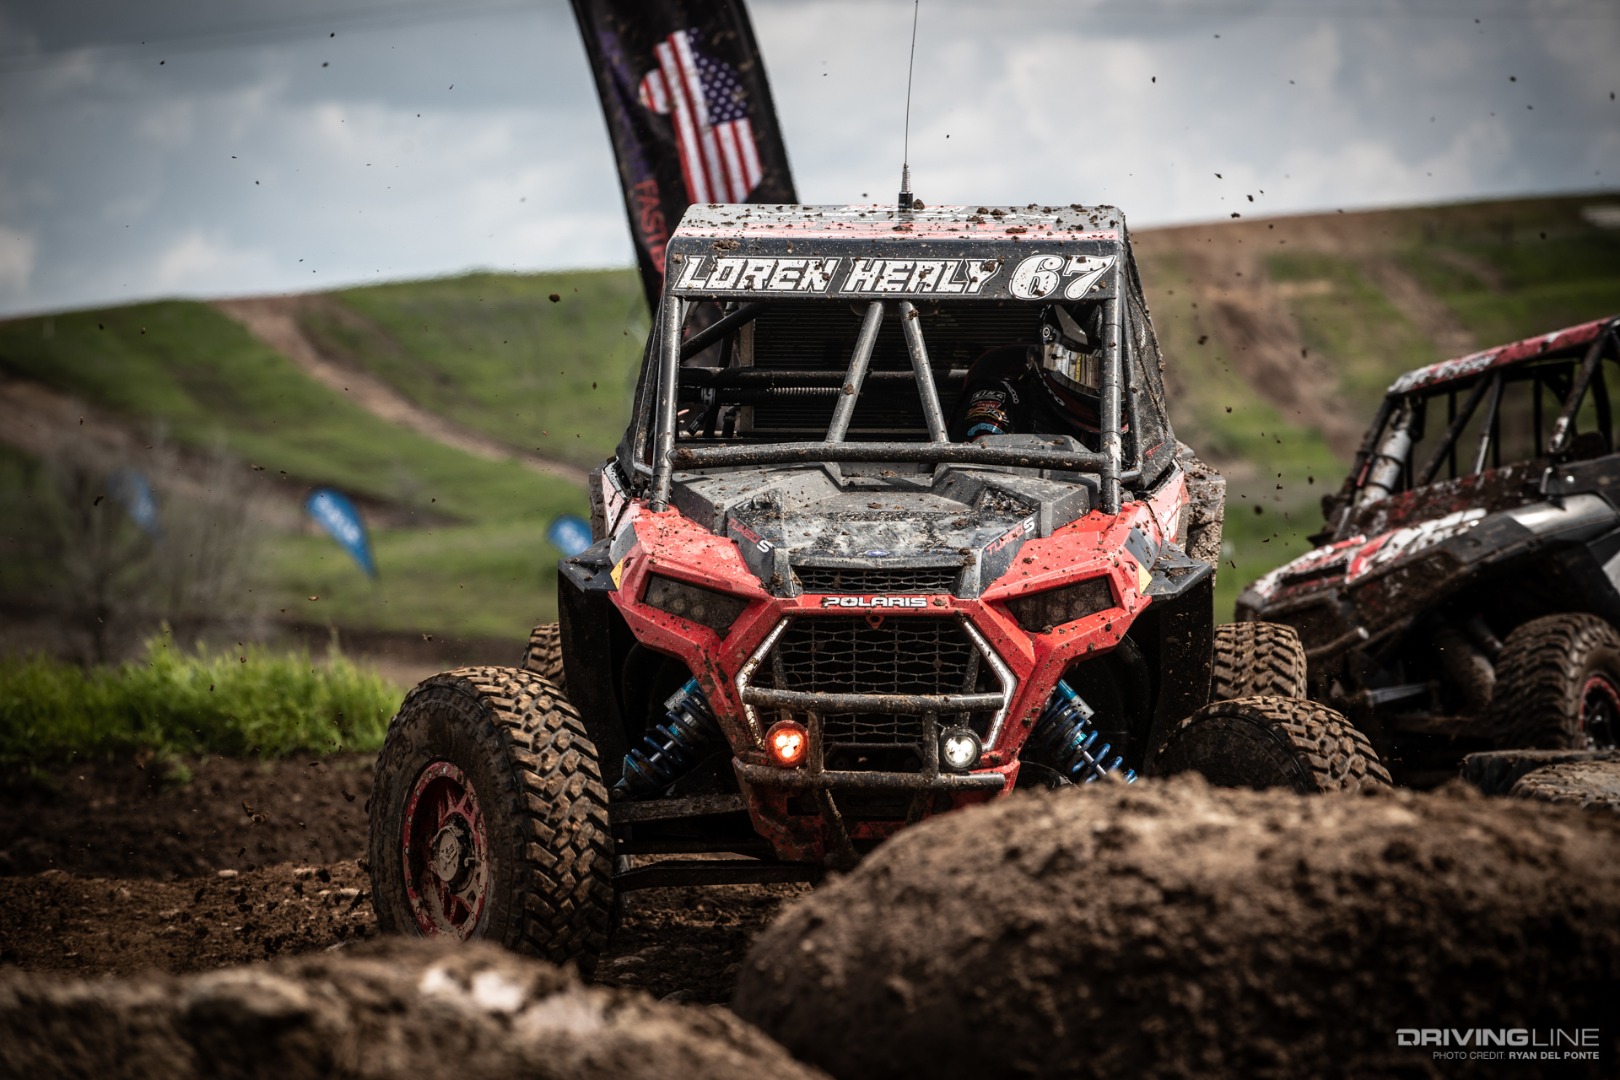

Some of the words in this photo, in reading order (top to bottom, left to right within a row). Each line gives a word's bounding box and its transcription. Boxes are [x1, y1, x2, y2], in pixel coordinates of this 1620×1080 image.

[671, 255, 843, 294] LOREN
[839, 255, 1000, 295] HEALY
[1007, 254, 1117, 300] 67
[728, 517, 762, 544] TURBO
[822, 596, 928, 609] POLARIS
